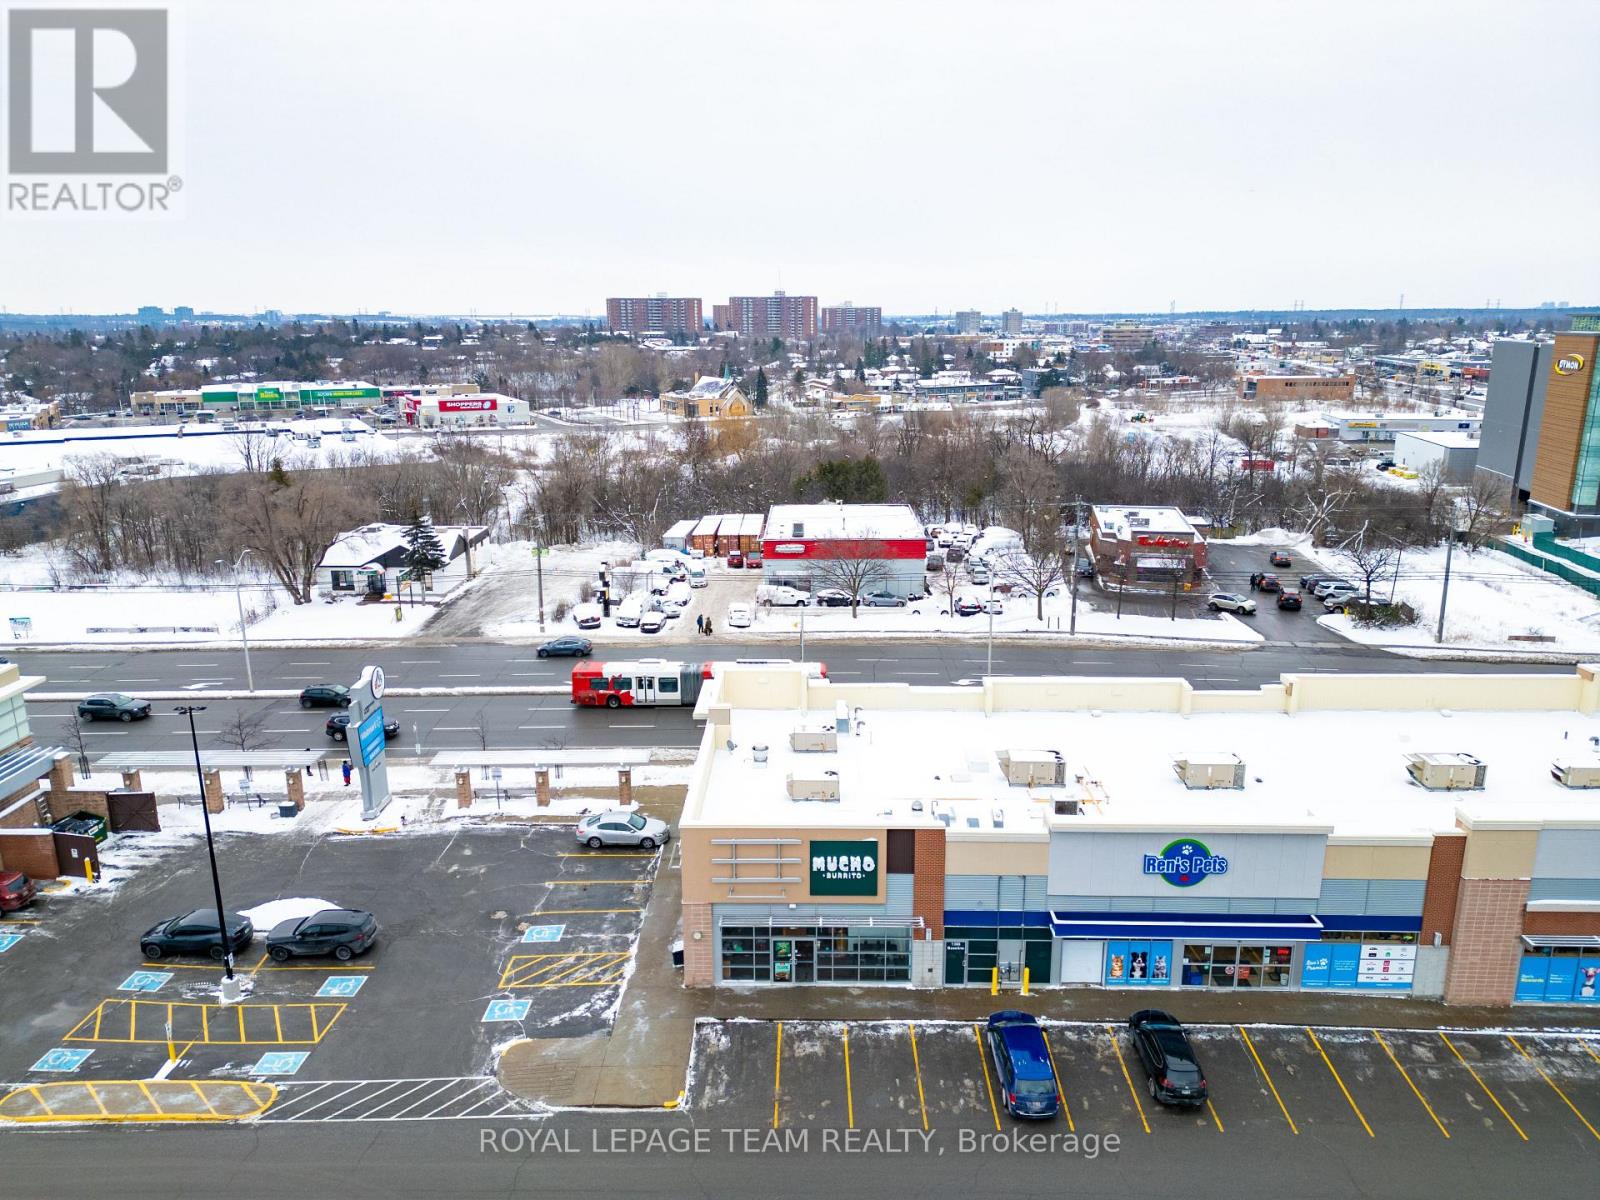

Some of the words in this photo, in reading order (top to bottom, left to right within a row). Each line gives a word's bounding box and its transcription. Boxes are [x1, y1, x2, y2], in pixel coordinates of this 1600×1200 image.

[812, 855, 875, 872] MUCHO
[1144, 855, 1190, 874] Ren's
[1192, 855, 1228, 874] Pets
